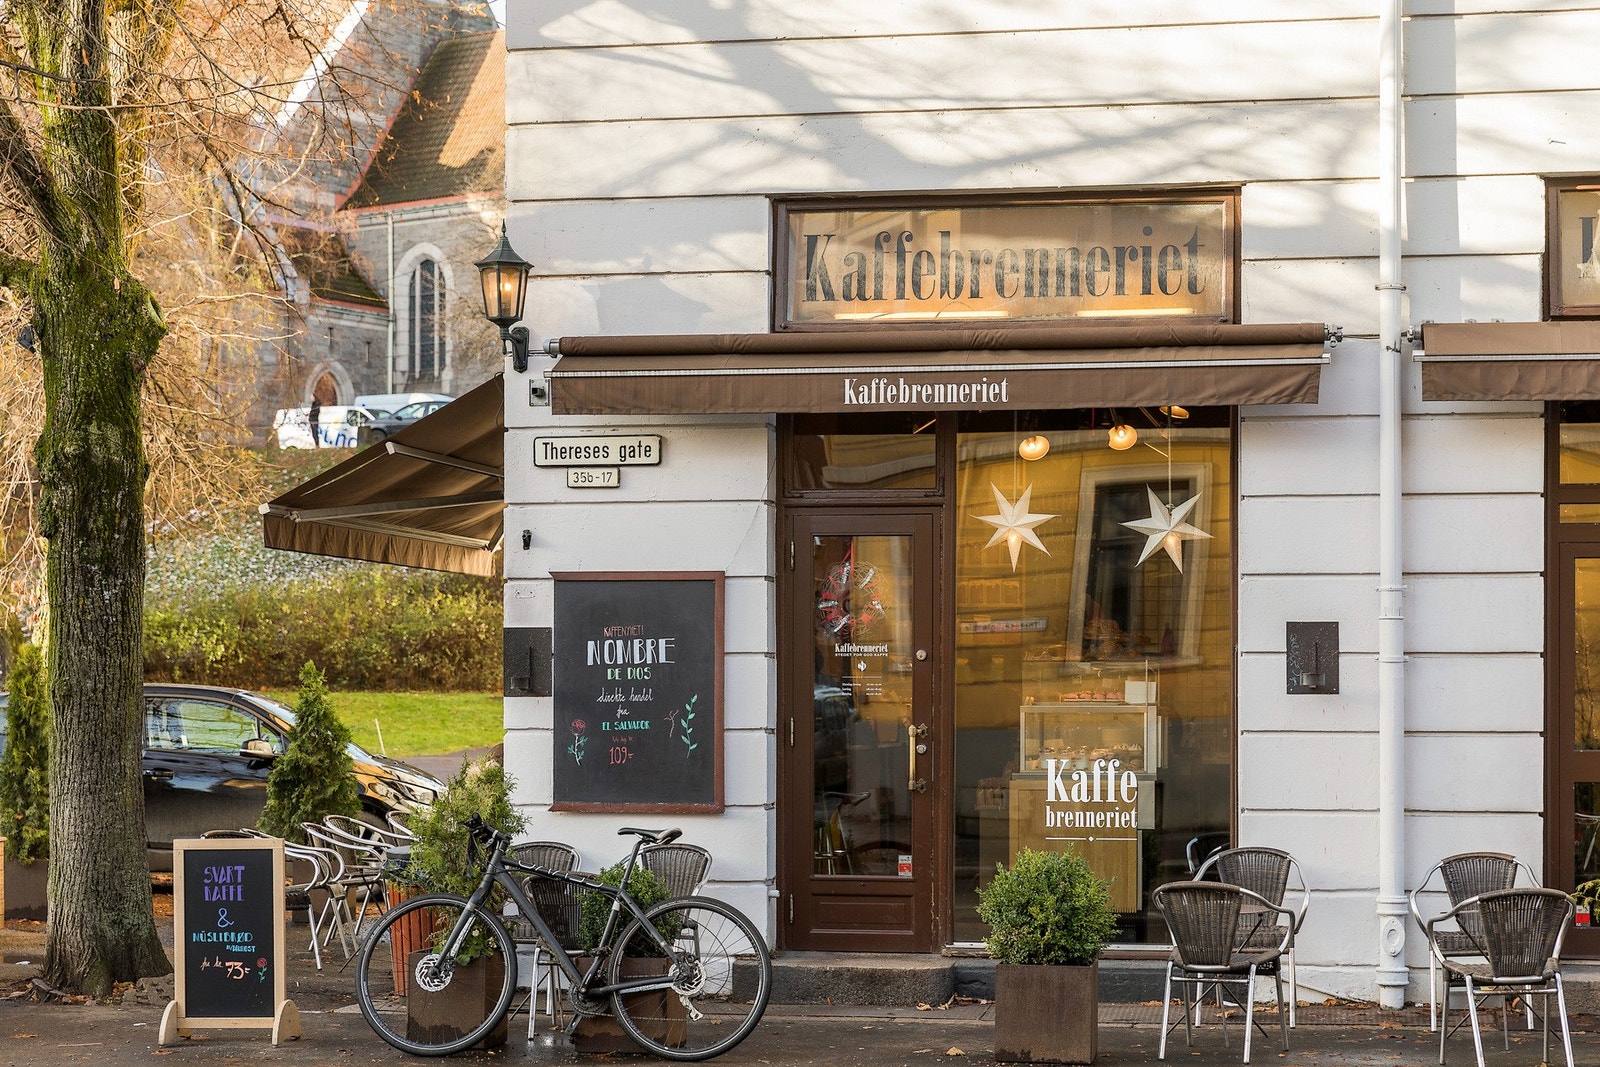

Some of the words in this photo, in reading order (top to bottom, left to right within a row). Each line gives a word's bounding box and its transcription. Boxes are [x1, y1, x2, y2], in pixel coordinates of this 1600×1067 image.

[802, 225, 1206, 302] Kaffebrenneriet
[843, 377, 1009, 405] Kaffebrenneriet
[542, 442, 610, 460] Thereses
[619, 440, 652, 462] gate
[573, 472, 613, 483] 35b-17
[587, 637, 676, 666] NOMBRE
[835, 642, 888, 653] Kaffebrenneriet
[607, 667, 622, 680] DE
[627, 667, 652, 680] DIOS
[602, 721, 611, 731] EL
[614, 720, 651, 731] SALVADOR
[1045, 758, 1138, 803] Kaffe
[1045, 805, 1138, 828] brenneriet
[203, 865, 245, 884] SVART
[204, 885, 245, 902] KAFFE
[217, 907, 235, 928] &
